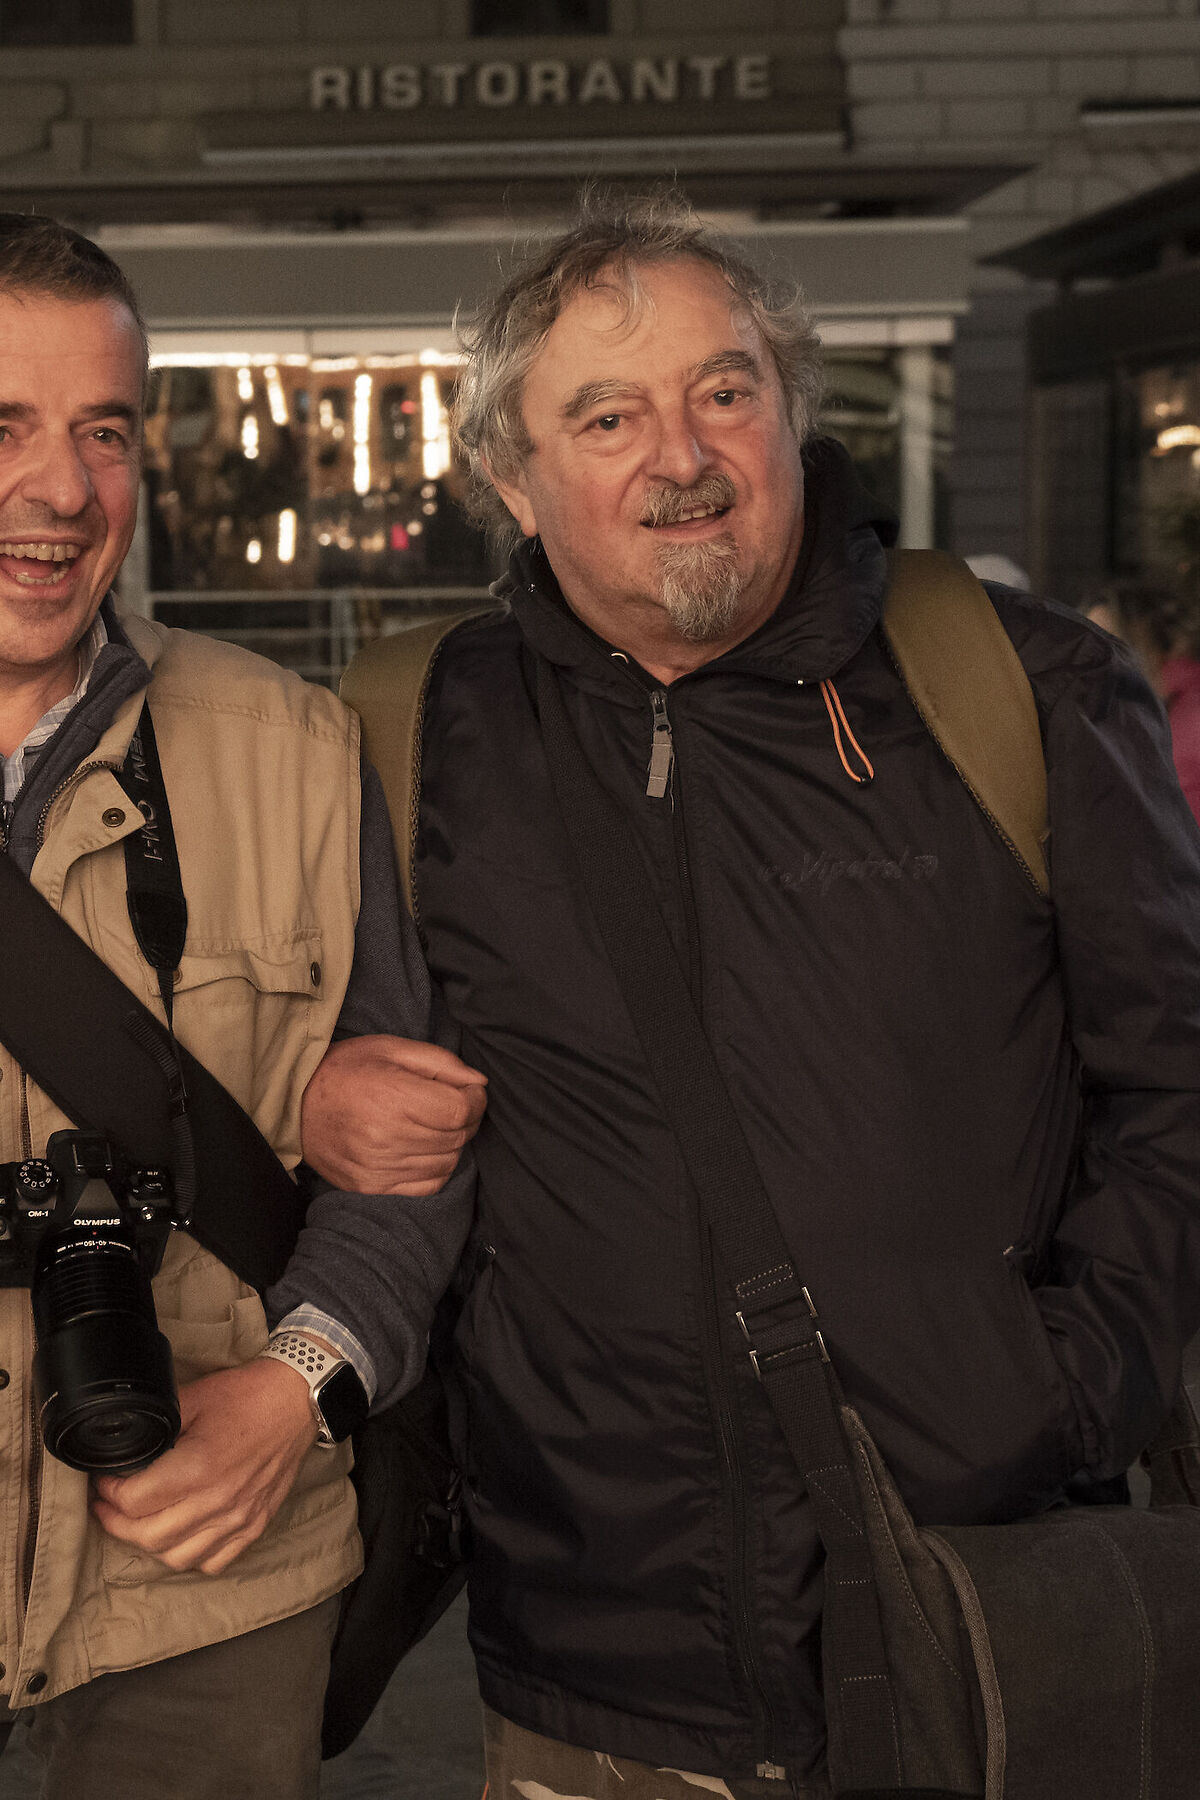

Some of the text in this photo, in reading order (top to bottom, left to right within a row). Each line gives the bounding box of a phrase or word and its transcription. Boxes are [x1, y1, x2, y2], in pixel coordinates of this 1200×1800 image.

[309, 54, 771, 110] RISTORANTE
[27, 1210, 49, 1218] OM-1
[73, 1218, 121, 1226] OLYMPUS
